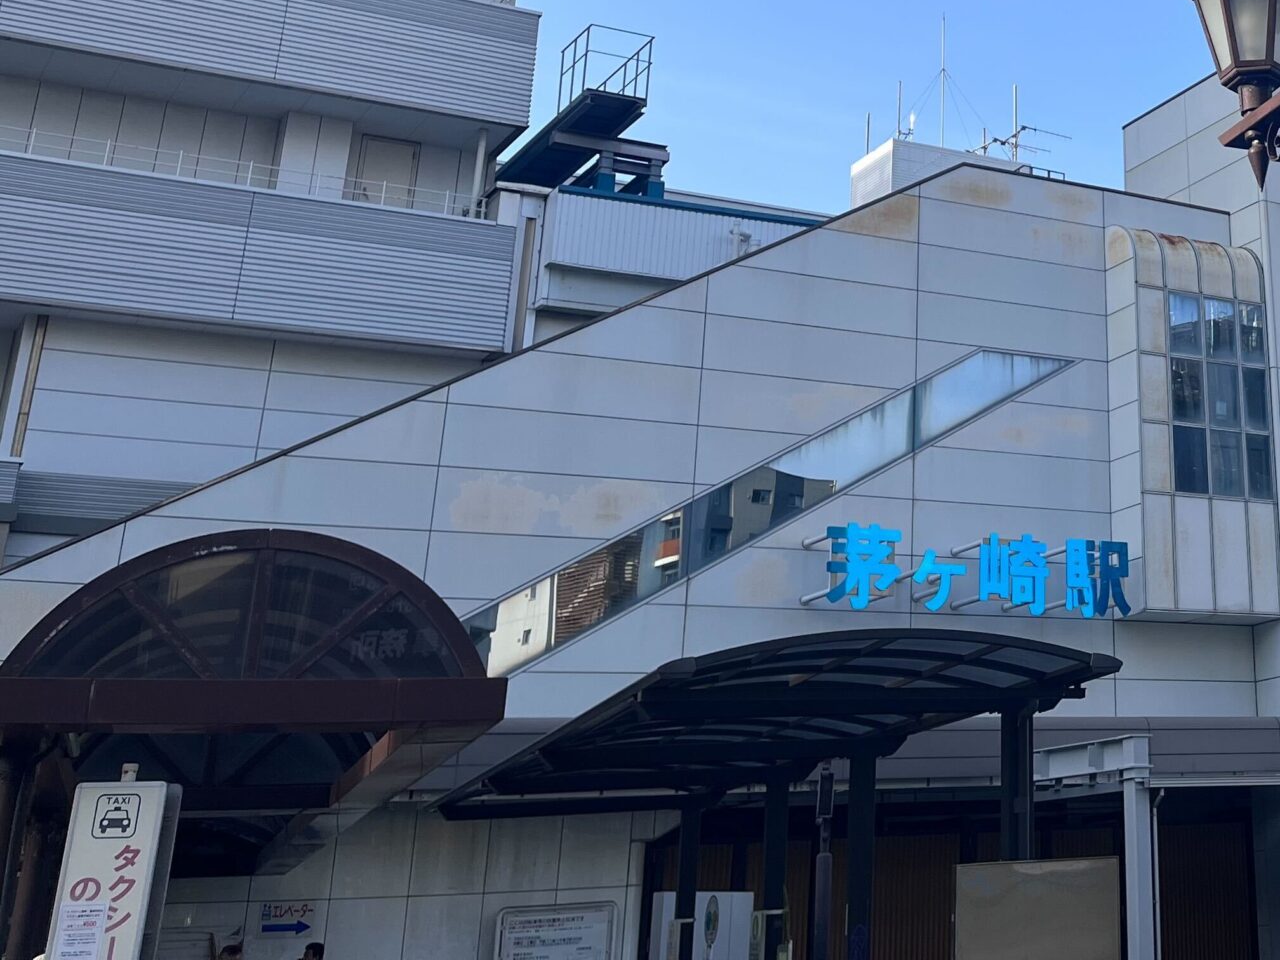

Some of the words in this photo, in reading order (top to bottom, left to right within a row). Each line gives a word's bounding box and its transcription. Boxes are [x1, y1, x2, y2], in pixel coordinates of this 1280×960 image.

[106, 796, 130, 805] TAXI
[69, 877, 101, 902] の
[104, 844, 141, 960] タクシー
[272, 903, 314, 919] エレベーター
